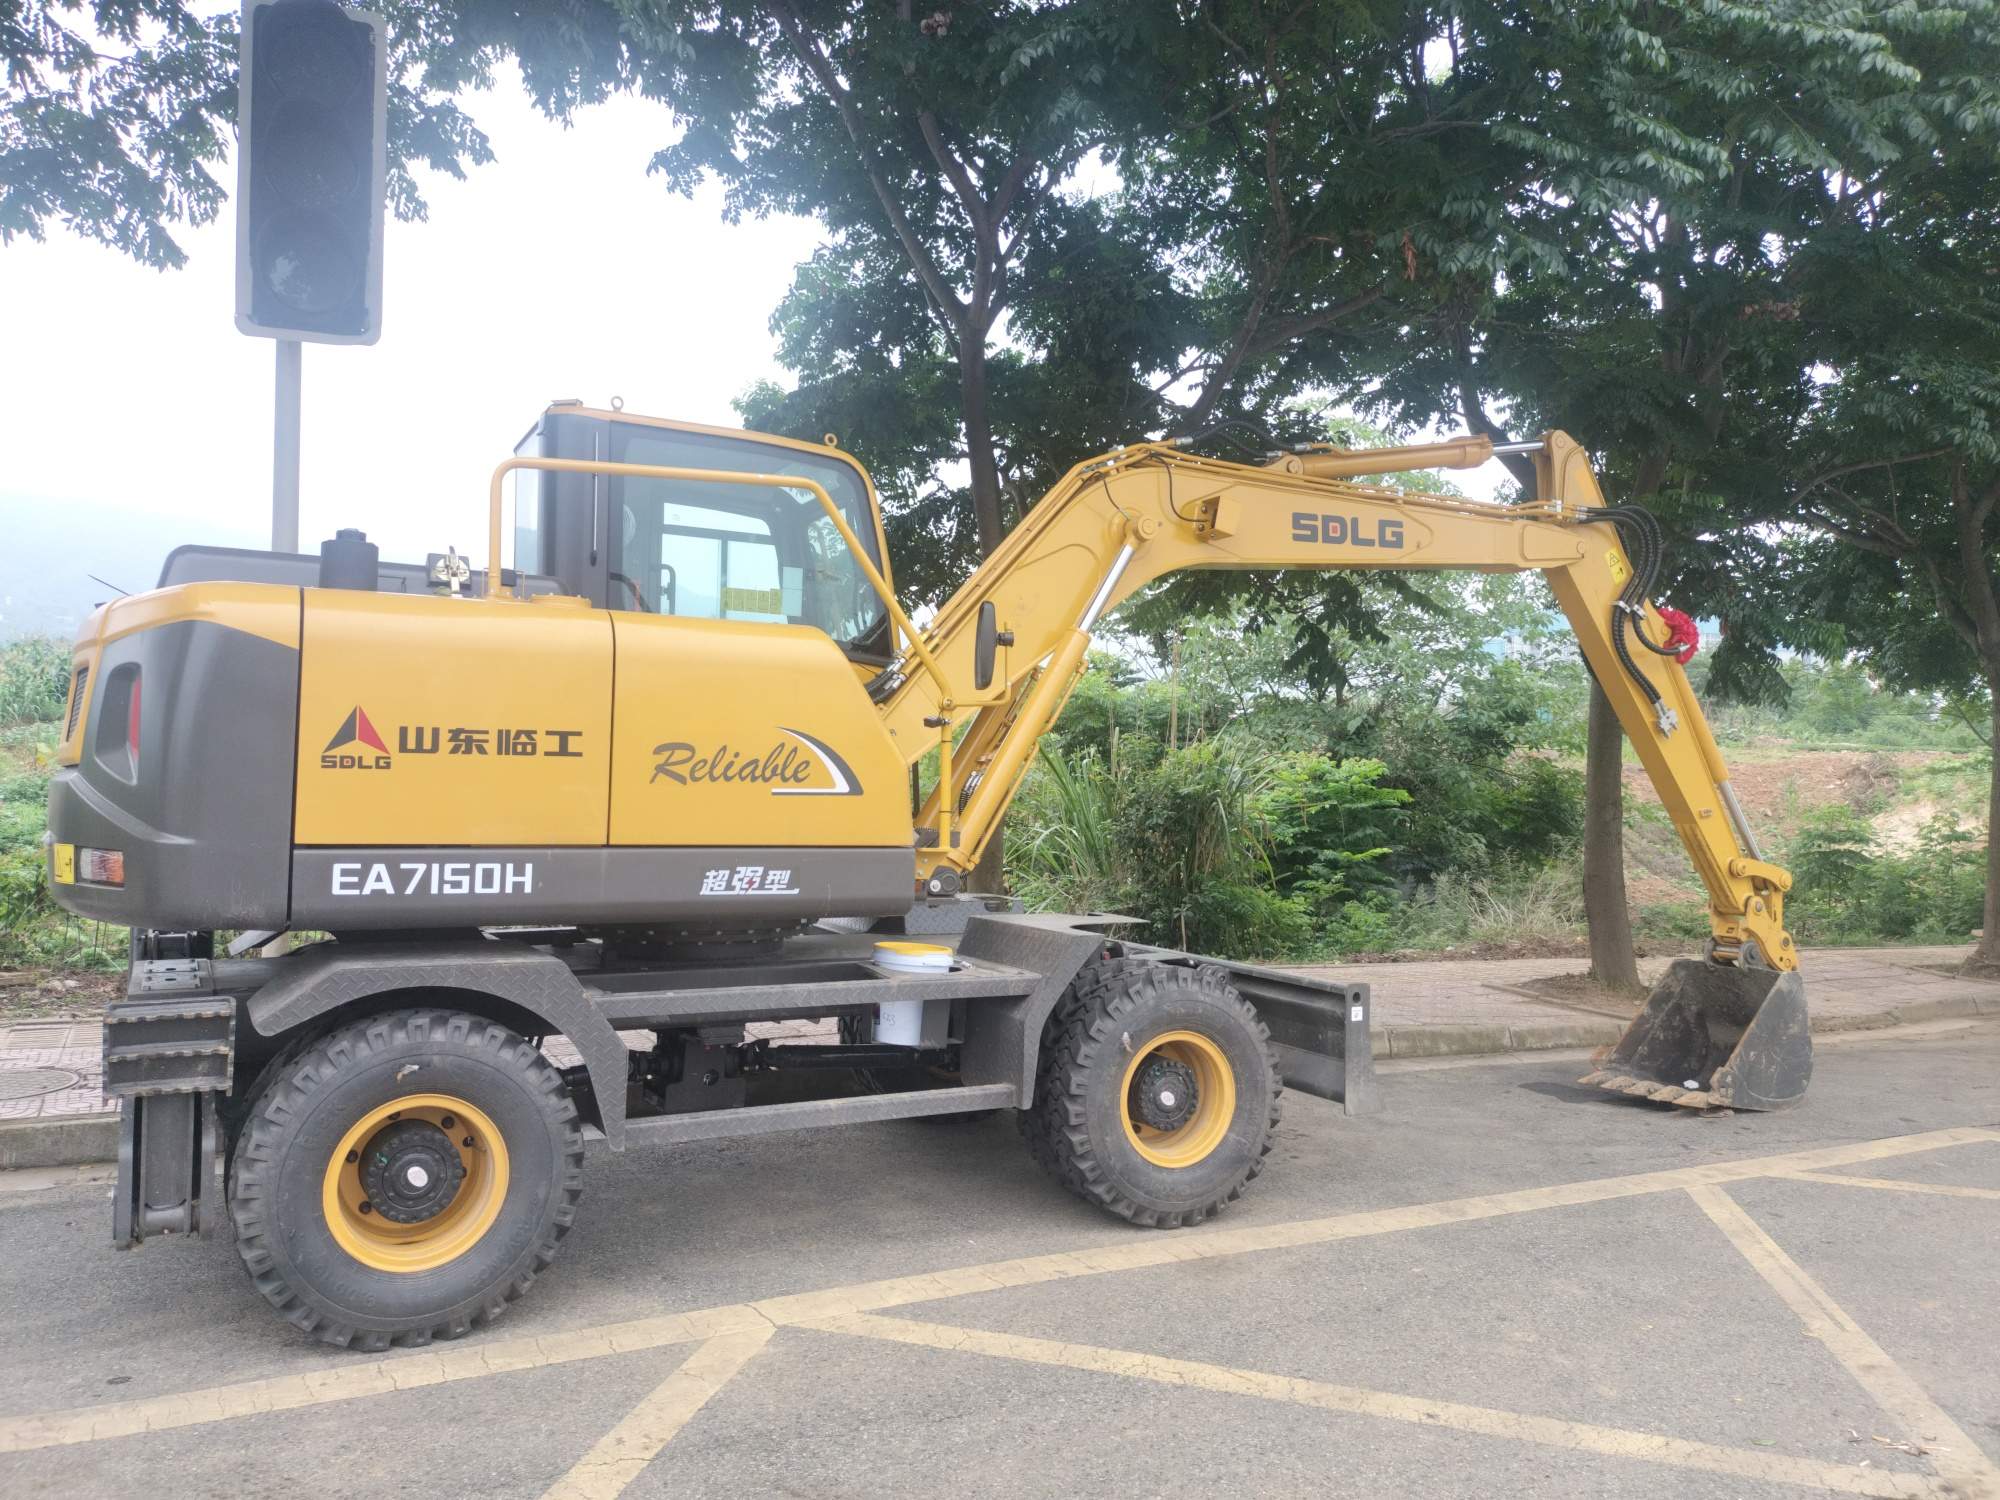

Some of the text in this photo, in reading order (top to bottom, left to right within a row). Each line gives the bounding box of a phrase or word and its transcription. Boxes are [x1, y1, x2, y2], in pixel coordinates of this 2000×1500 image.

[1292, 512, 1404, 549] SDLG
[398, 726, 583, 757] 山东临工
[320, 755, 391, 769] SDLG
[650, 742, 810, 786] Reliable
[331, 863, 533, 895] EA7150H
[700, 866, 800, 895] 超强型
